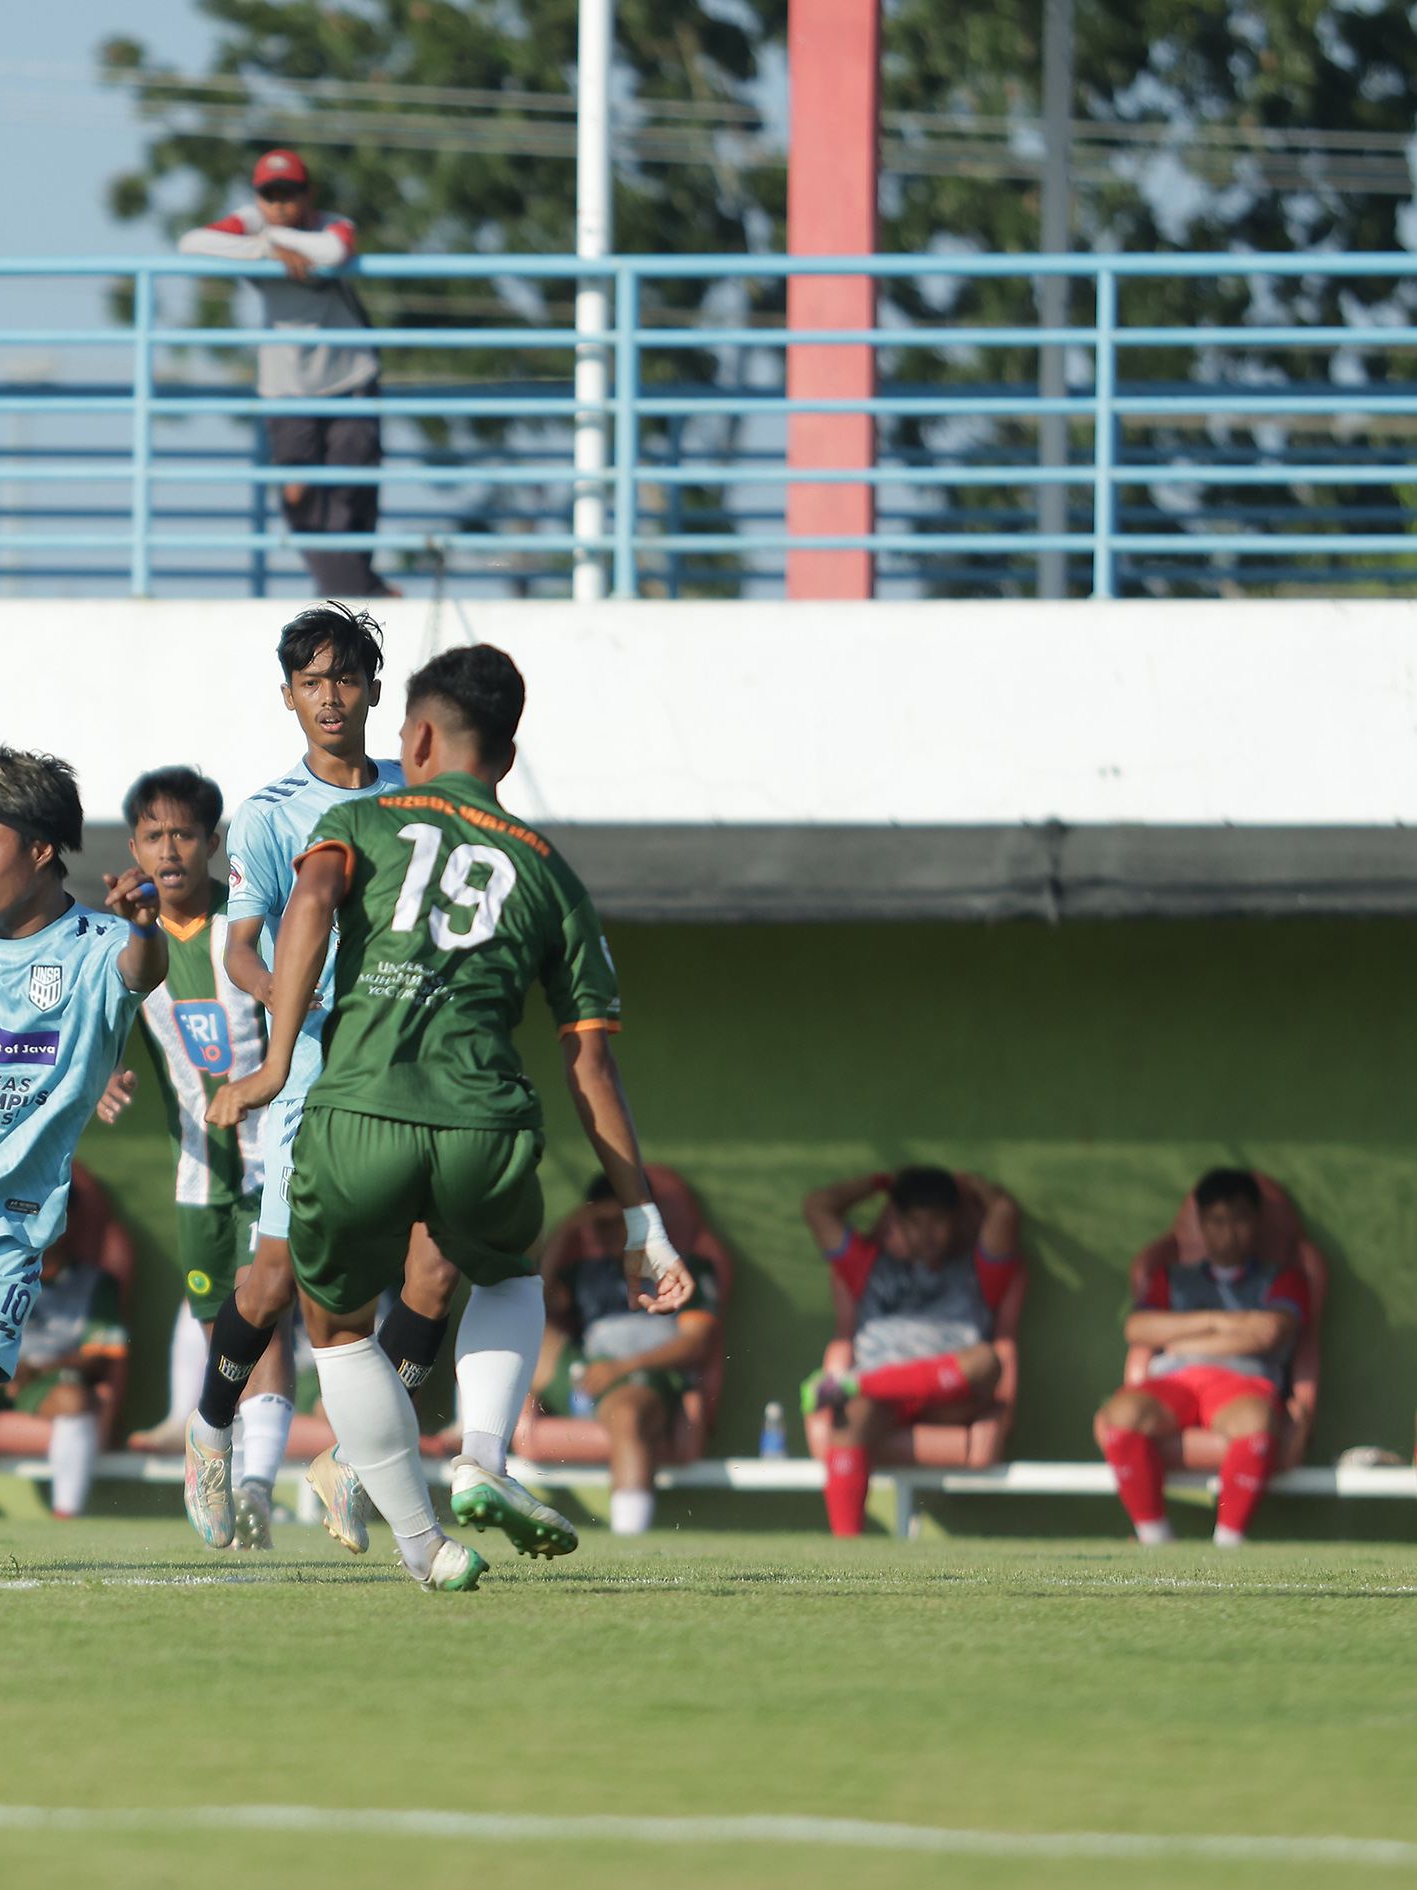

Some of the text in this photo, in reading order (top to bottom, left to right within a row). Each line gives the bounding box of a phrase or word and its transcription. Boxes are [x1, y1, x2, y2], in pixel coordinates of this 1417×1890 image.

[391, 822, 516, 951] 19
[32, 966, 61, 985] UNSA
[4, 1043, 19, 1054] of
[22, 1044, 56, 1054] Java
[1, 1283, 31, 1326] 10
